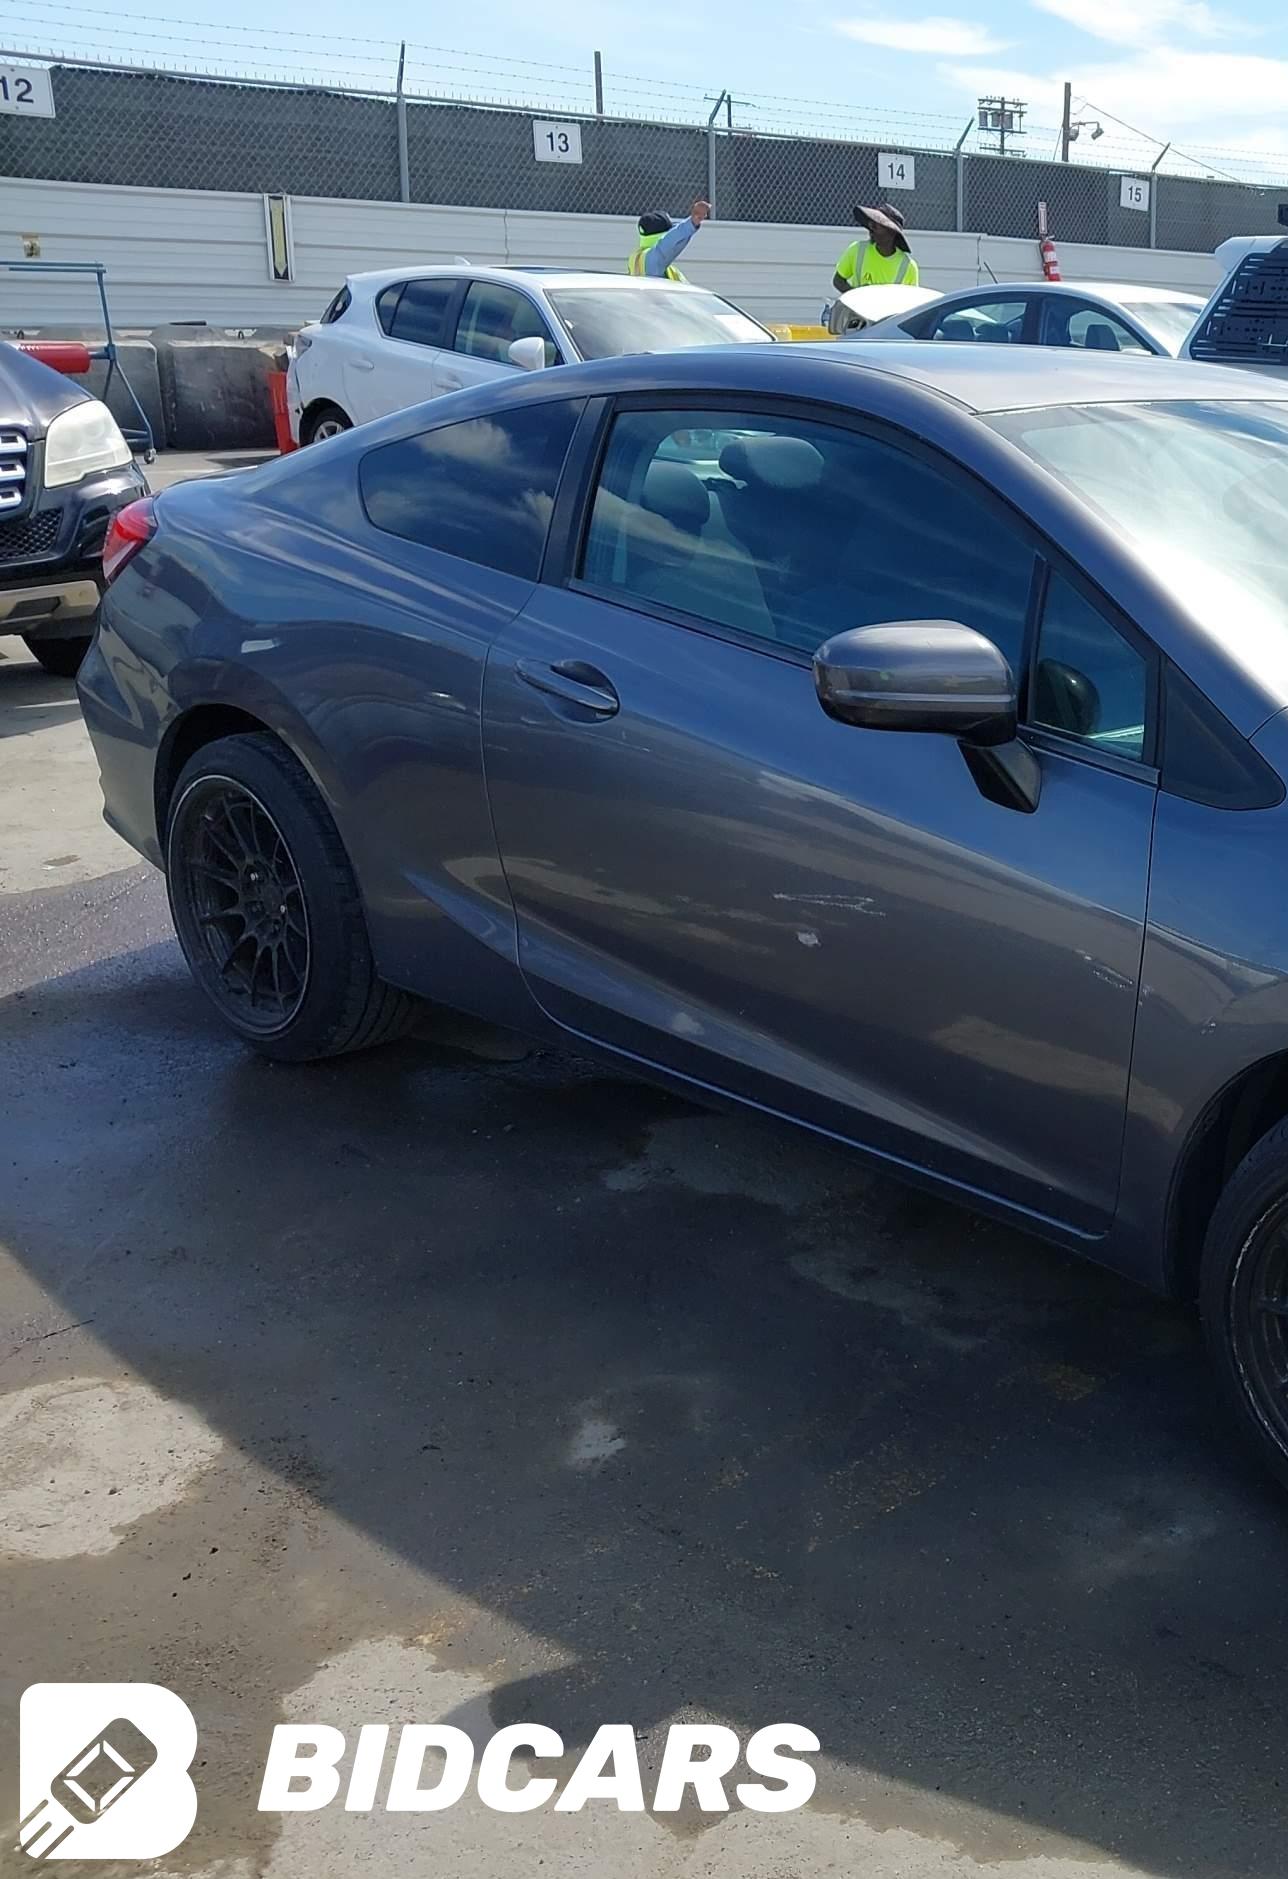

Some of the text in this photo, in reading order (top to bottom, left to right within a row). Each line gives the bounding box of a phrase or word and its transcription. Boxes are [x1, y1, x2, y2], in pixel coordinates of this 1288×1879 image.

[0, 75, 34, 104] 12
[546, 131, 569, 153] 13
[887, 162, 905, 181] 14
[1128, 185, 1142, 202] 15
